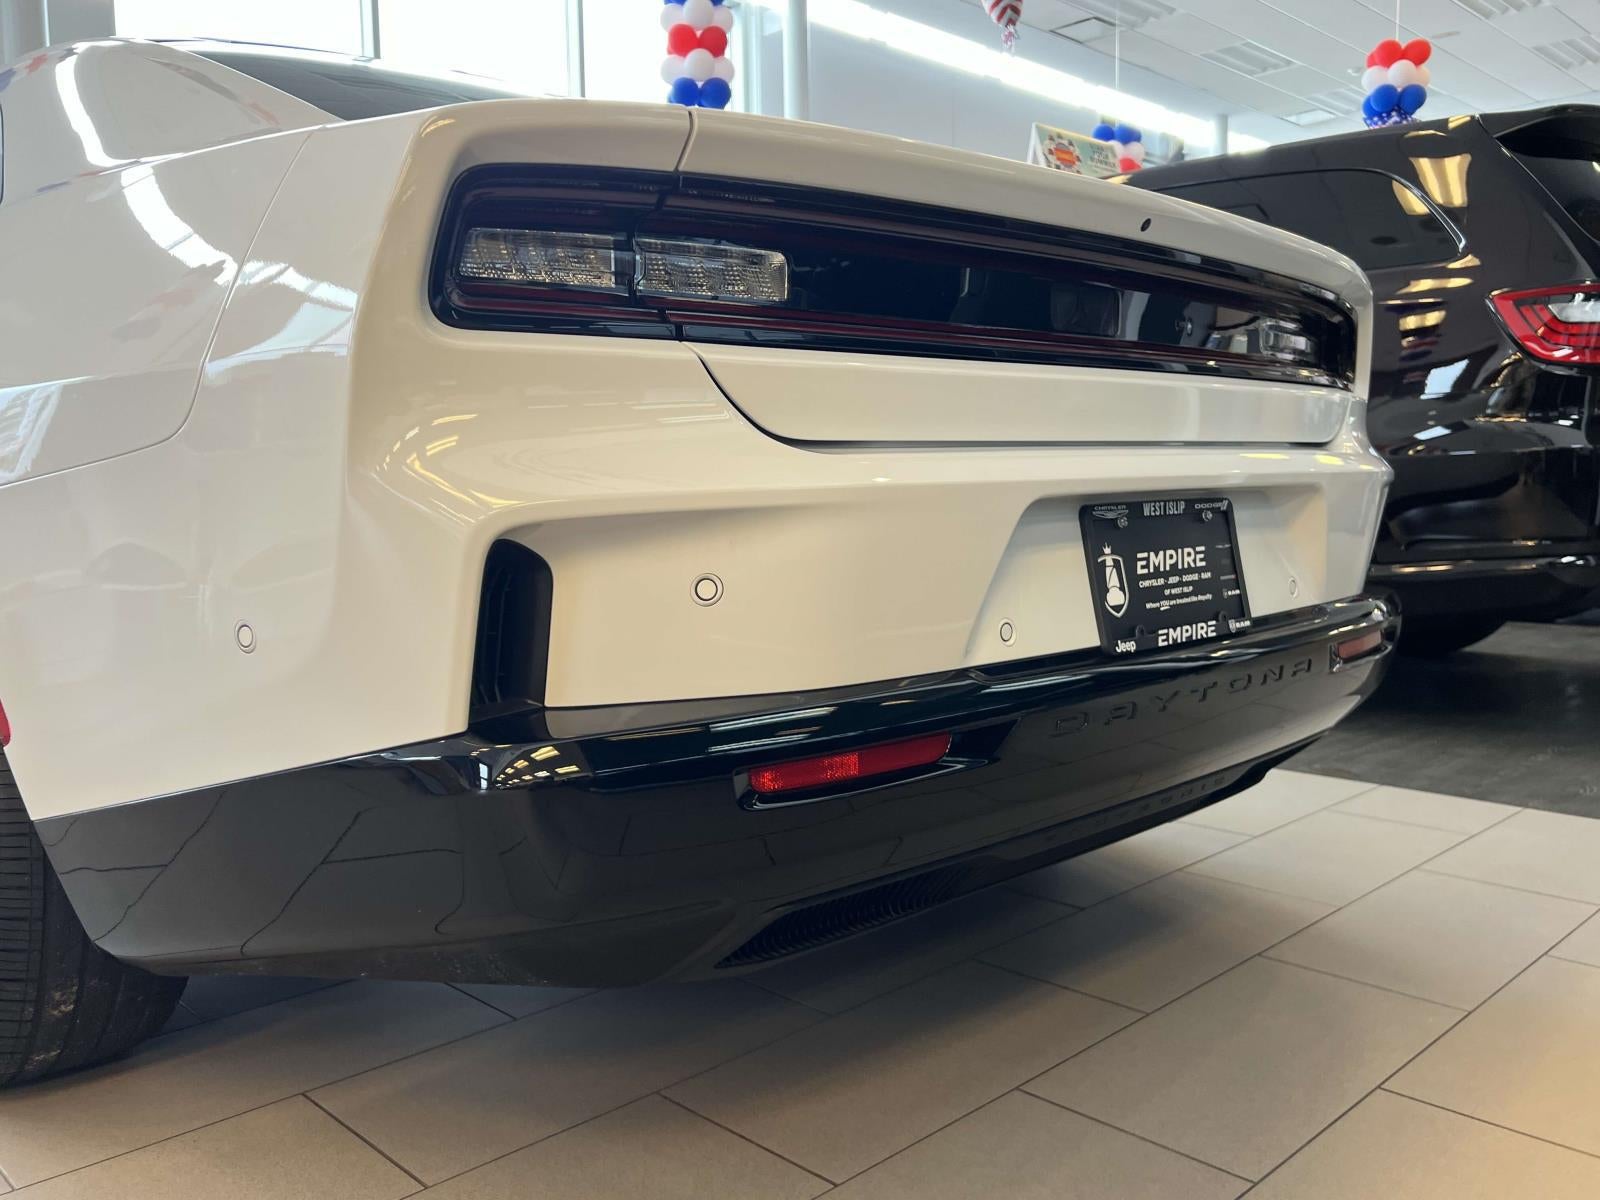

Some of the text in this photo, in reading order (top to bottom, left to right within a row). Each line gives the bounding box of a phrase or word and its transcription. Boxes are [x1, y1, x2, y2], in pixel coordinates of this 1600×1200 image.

[1143, 501, 1186, 516] WEST ISLIP
[1136, 547, 1206, 574] EMPIRE
[1139, 578, 1165, 588] CHRYSLER
[1168, 576, 1180, 584] JEEP
[1182, 573, 1199, 582] DODGE
[1171, 586, 1183, 595] WEST
[1160, 600, 1170, 608] YOU
[1235, 620, 1251, 629] RAM
[1157, 620, 1217, 647] EMPIRE
[1115, 640, 1137, 653] Jeep
[1052, 658, 1313, 738] DAYTONA
